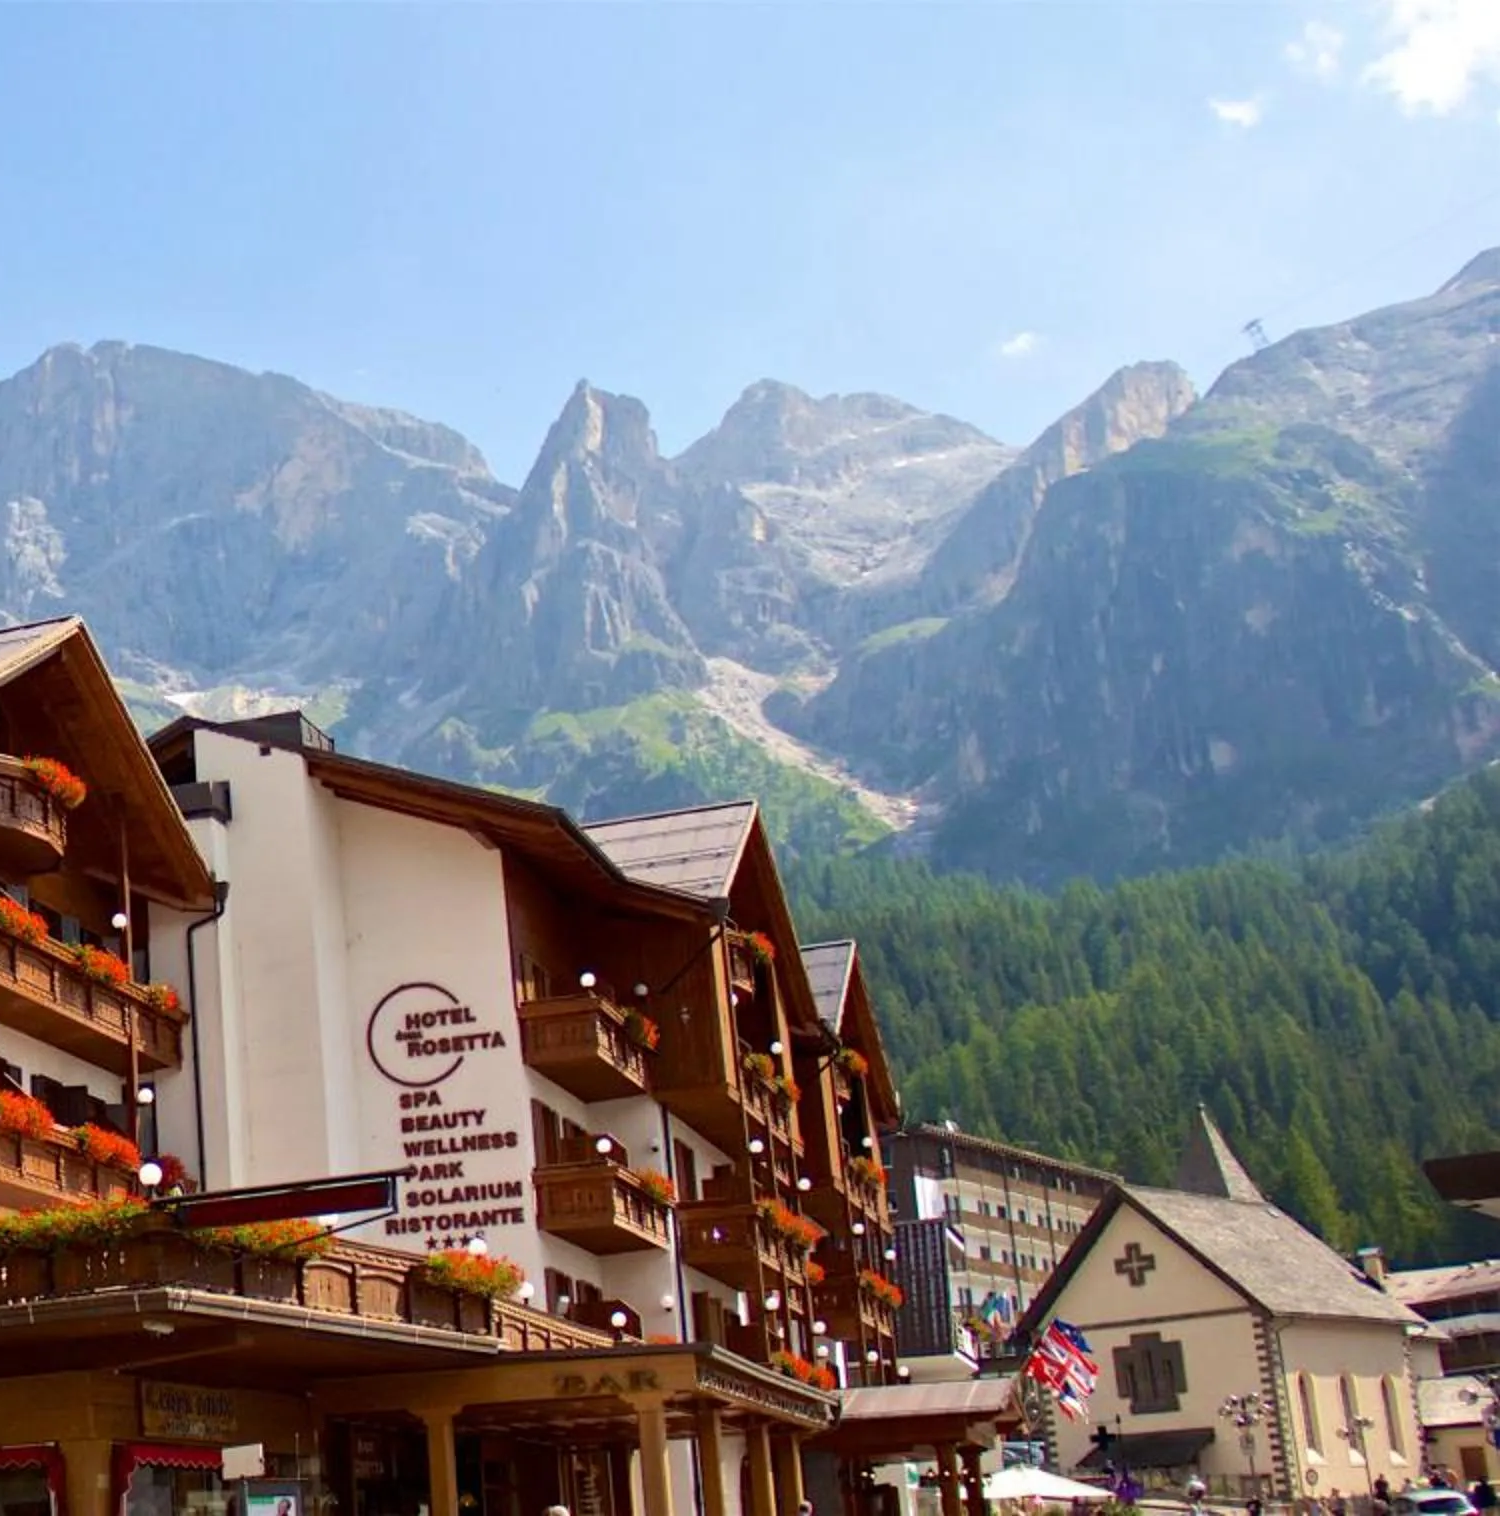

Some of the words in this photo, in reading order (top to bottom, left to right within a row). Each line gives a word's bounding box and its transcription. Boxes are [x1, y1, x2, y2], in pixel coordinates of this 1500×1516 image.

[404, 1007, 477, 1031] HOTEL
[407, 1031, 506, 1058] ROSETTA
[398, 1090, 442, 1110] SPA
[400, 1109, 487, 1134] BEAUTY
[402, 1131, 519, 1158] WELLNESS
[404, 1161, 464, 1182] PARK
[405, 1181, 523, 1208] SOLARIUM
[384, 1207, 525, 1236] RISTORANTE
[555, 1369, 659, 1395] BAR
